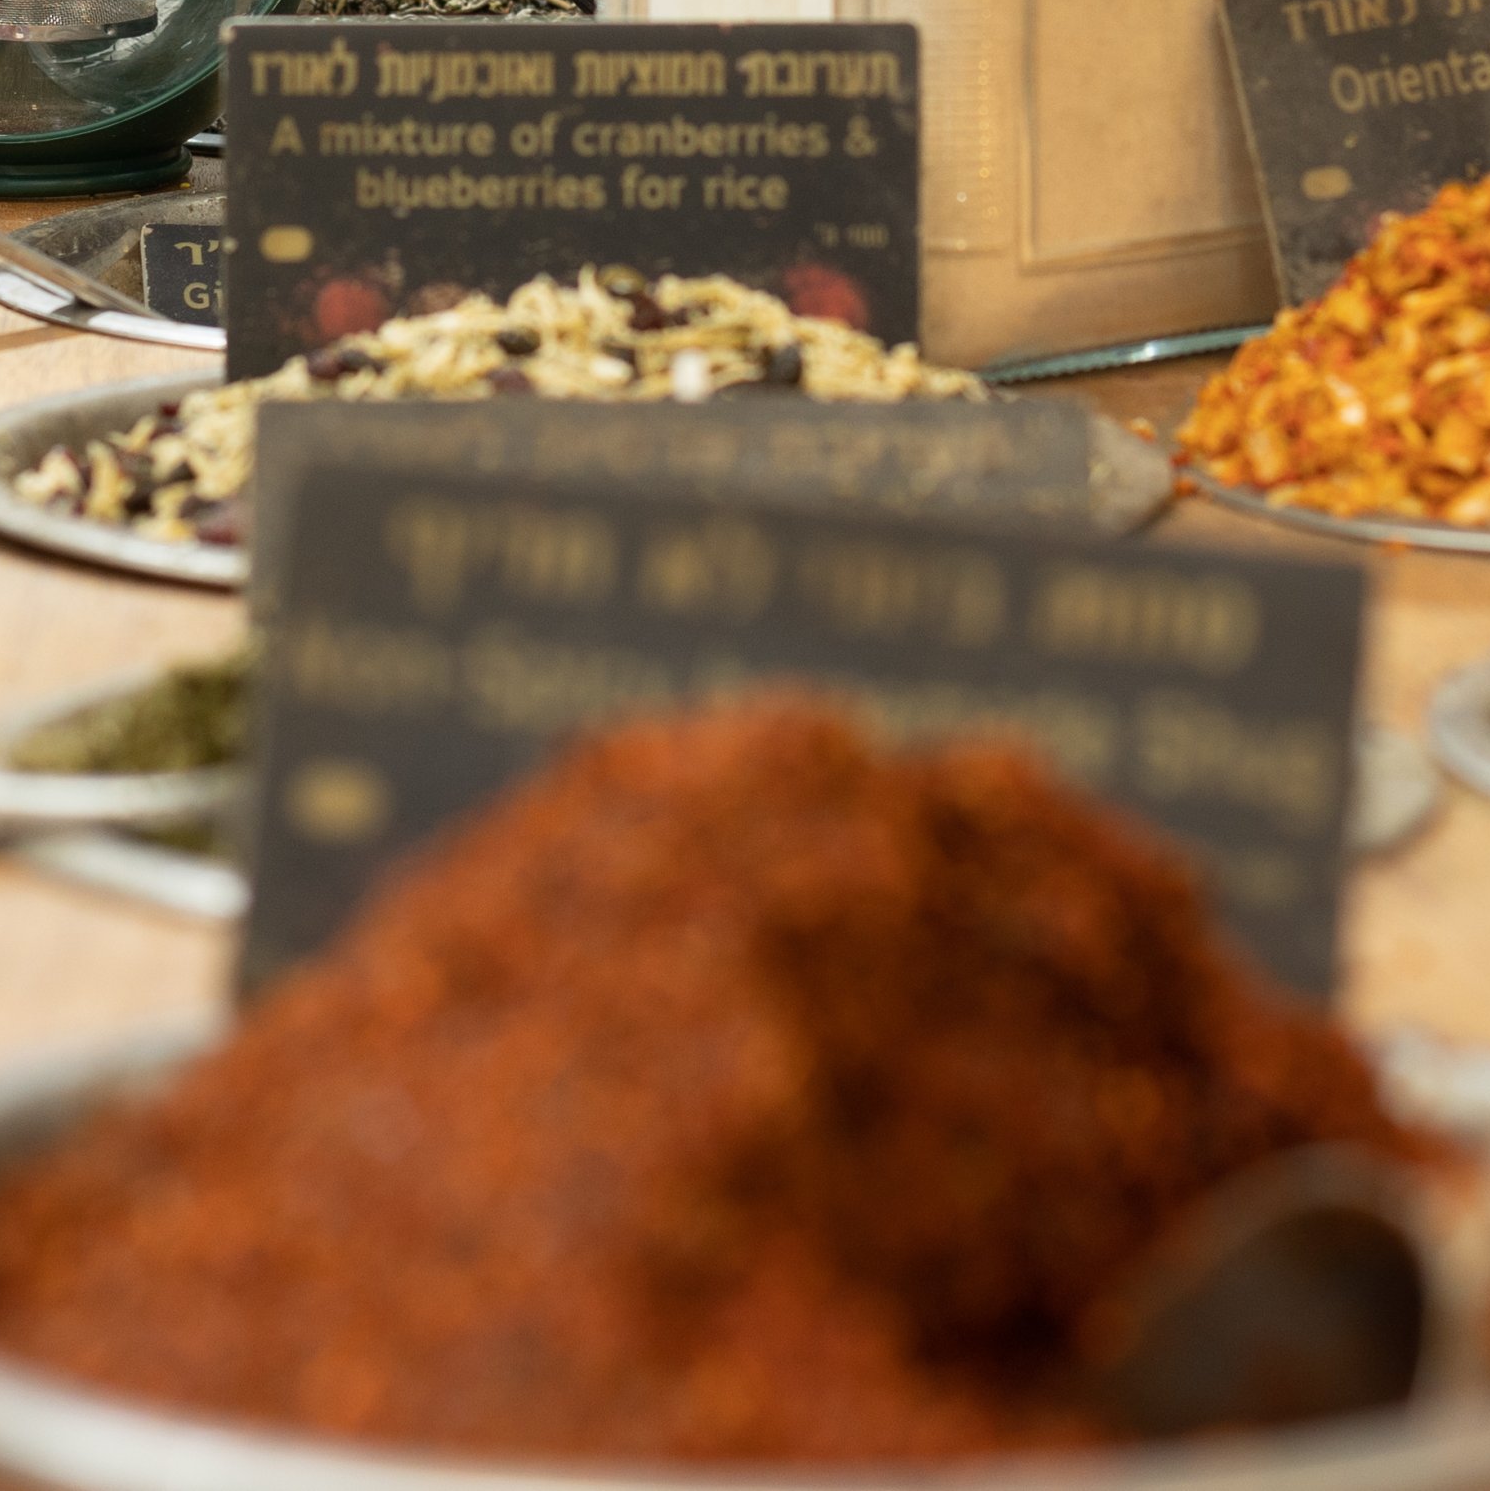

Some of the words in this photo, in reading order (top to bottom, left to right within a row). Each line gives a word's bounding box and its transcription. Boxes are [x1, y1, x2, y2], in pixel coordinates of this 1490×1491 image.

[269, 114, 306, 157] A
[317, 111, 497, 158] mixture
[510, 111, 561, 158] of
[572, 113, 831, 158] cranberries
[843, 114, 879, 157] &
[356, 164, 607, 210] blueberries
[620, 163, 688, 210] for
[702, 164, 790, 210] rice
